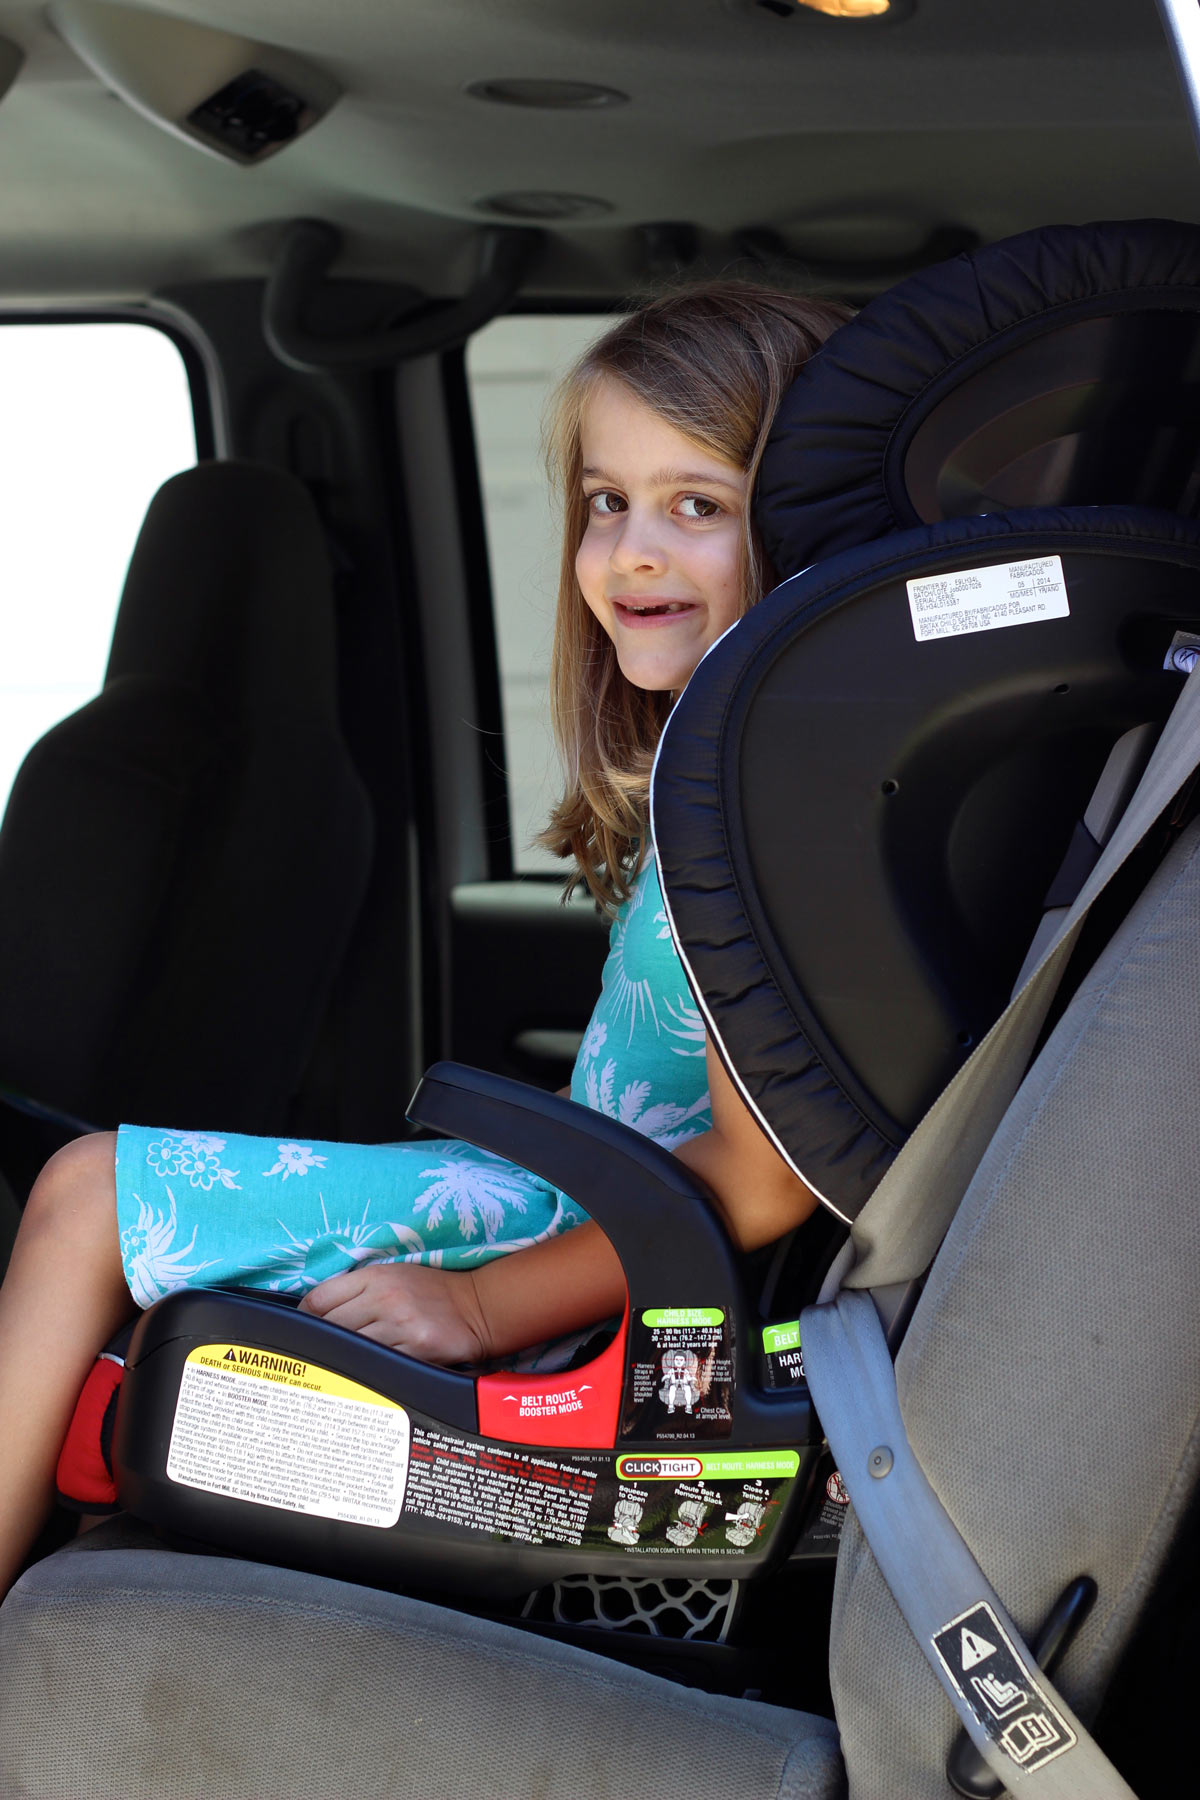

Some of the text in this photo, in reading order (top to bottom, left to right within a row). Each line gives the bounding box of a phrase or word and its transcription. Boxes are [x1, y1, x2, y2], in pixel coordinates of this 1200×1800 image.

[1009, 560, 1053, 573] MANUFACTURED
[913, 583, 939, 592] FRONTIER
[1036, 577, 1051, 585] 2014
[919, 601, 1020, 624] MANUFACTURED BY/FABRICADOS POR
[920, 622, 939, 630] BRITAX
[940, 619, 957, 627] CHILD
[1009, 605, 1036, 616] PLEASANT
[921, 629, 935, 637] FORT
[979, 619, 991, 627] USA
[664, 1309, 684, 1317] CHILD
[692, 1317, 712, 1325] MODE
[774, 1332, 798, 1346] BELT
[200, 1356, 221, 1368] DEATH
[232, 1364, 261, 1377] SERIOUS
[263, 1371, 287, 1383] INJURY
[289, 1379, 301, 1387] can
[238, 1350, 306, 1378] WARNING!
[522, 1390, 577, 1406] BELT ROUTE
[520, 1400, 583, 1416] BOOSTER MODE
[413, 1436, 431, 1446] vehicle
[433, 1441, 449, 1452] safety
[451, 1446, 477, 1457] standards.
[414, 1428, 424, 1437] This
[427, 1431, 440, 1440] child
[442, 1435, 464, 1446] restraint
[466, 1441, 485, 1453] system
[487, 1447, 512, 1458] conforms
[530, 1457, 558, 1471] applicable
[560, 1464, 580, 1475] Federal
[582, 1470, 597, 1479] motor
[746, 1461, 774, 1470] HARNESS
[776, 1461, 794, 1469] MODE
[178, 1473, 206, 1485] Manufactured
[212, 1481, 221, 1489] Fort
[250, 1491, 256, 1499] by
[270, 1496, 281, 1504] Child
[619, 1485, 648, 1497] Squeeze
[675, 1488, 722, 1505] Remove Slack
[679, 1483, 699, 1493] Route
[701, 1489, 714, 1497] Belt
[743, 1484, 763, 1494] Close
[743, 1492, 763, 1501] Tether
[627, 1494, 645, 1503] Open
[405, 1504, 419, 1514] (TTY:
[471, 1521, 478, 1530] go
[406, 1497, 415, 1505] call
[416, 1500, 425, 1508] the
[426, 1502, 436, 1510] U.S.
[438, 1505, 473, 1519] Government's
[475, 1514, 493, 1524] Vehicle
[495, 1519, 511, 1530] Safety
[512, 1523, 530, 1533] Hotline
